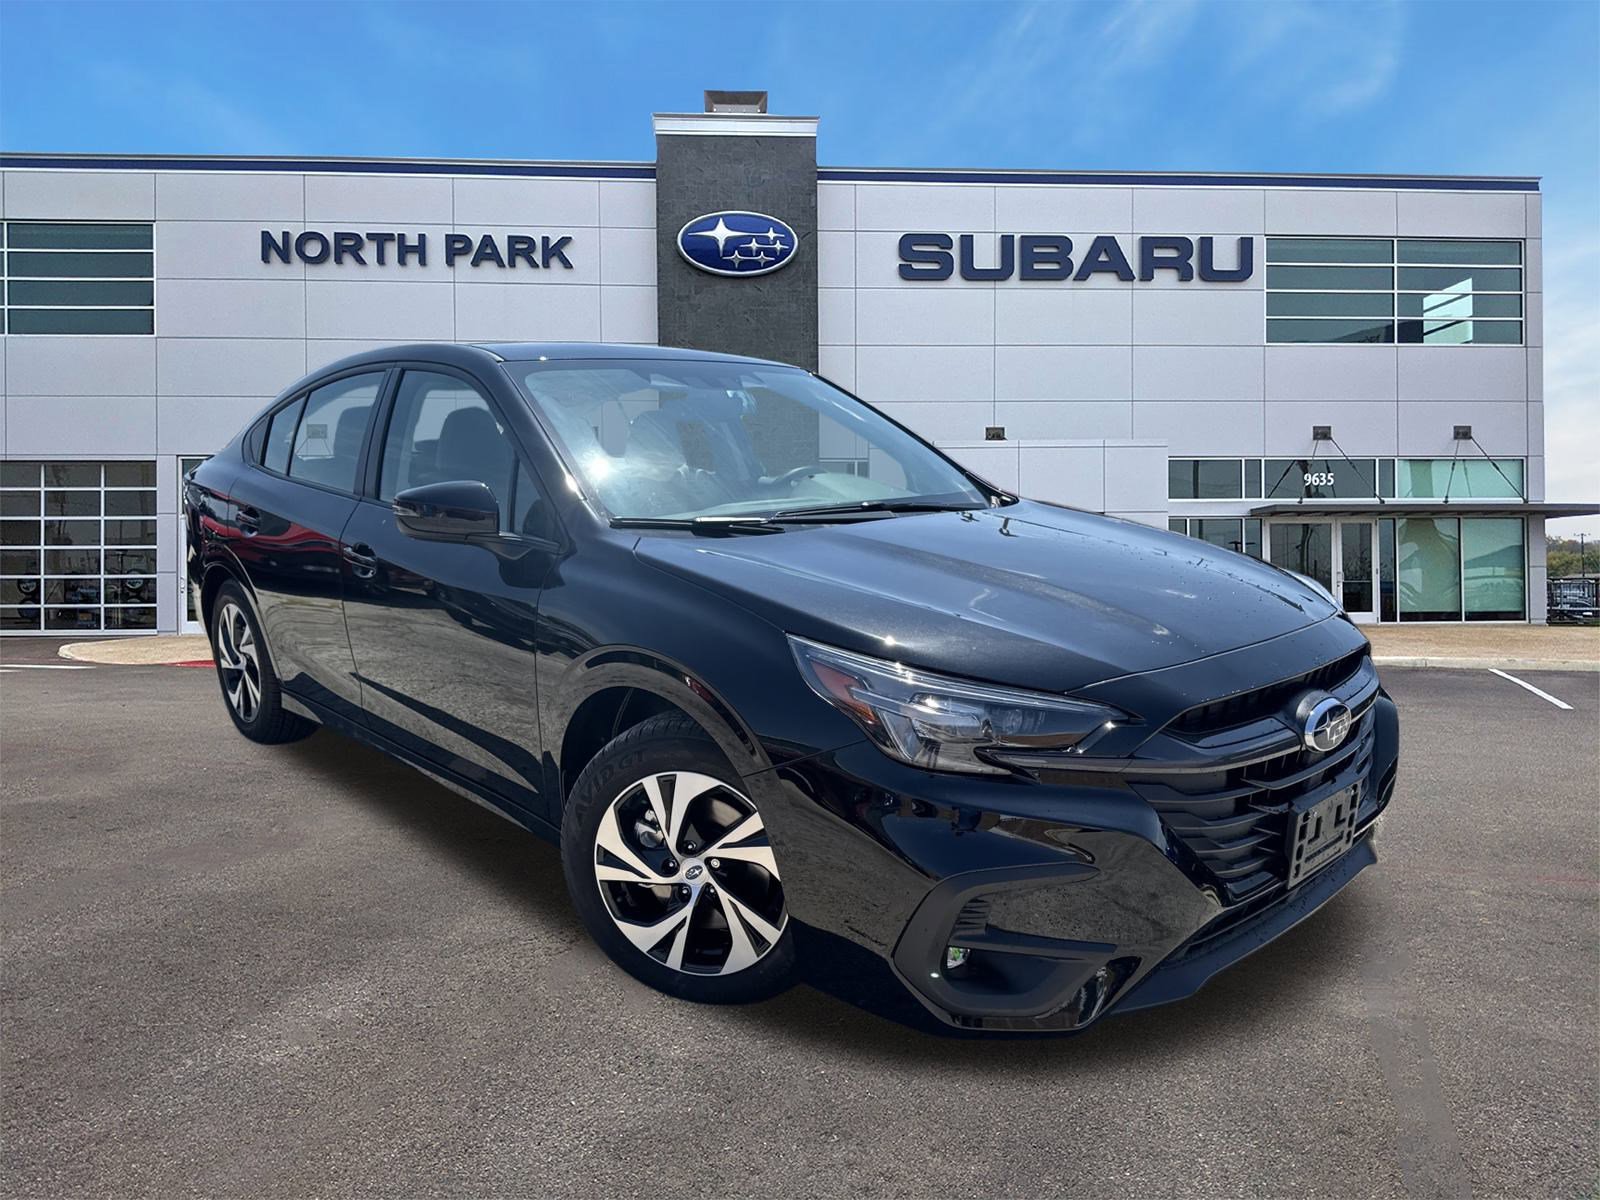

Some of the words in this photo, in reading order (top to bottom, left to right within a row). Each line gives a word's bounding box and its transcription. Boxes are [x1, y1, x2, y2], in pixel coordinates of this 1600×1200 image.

[260, 230, 427, 266] NORTH
[444, 233, 574, 269] PARK
[898, 232, 1254, 282] SUBARU
[1303, 472, 1335, 486] 9635
[575, 763, 616, 829] AVID
